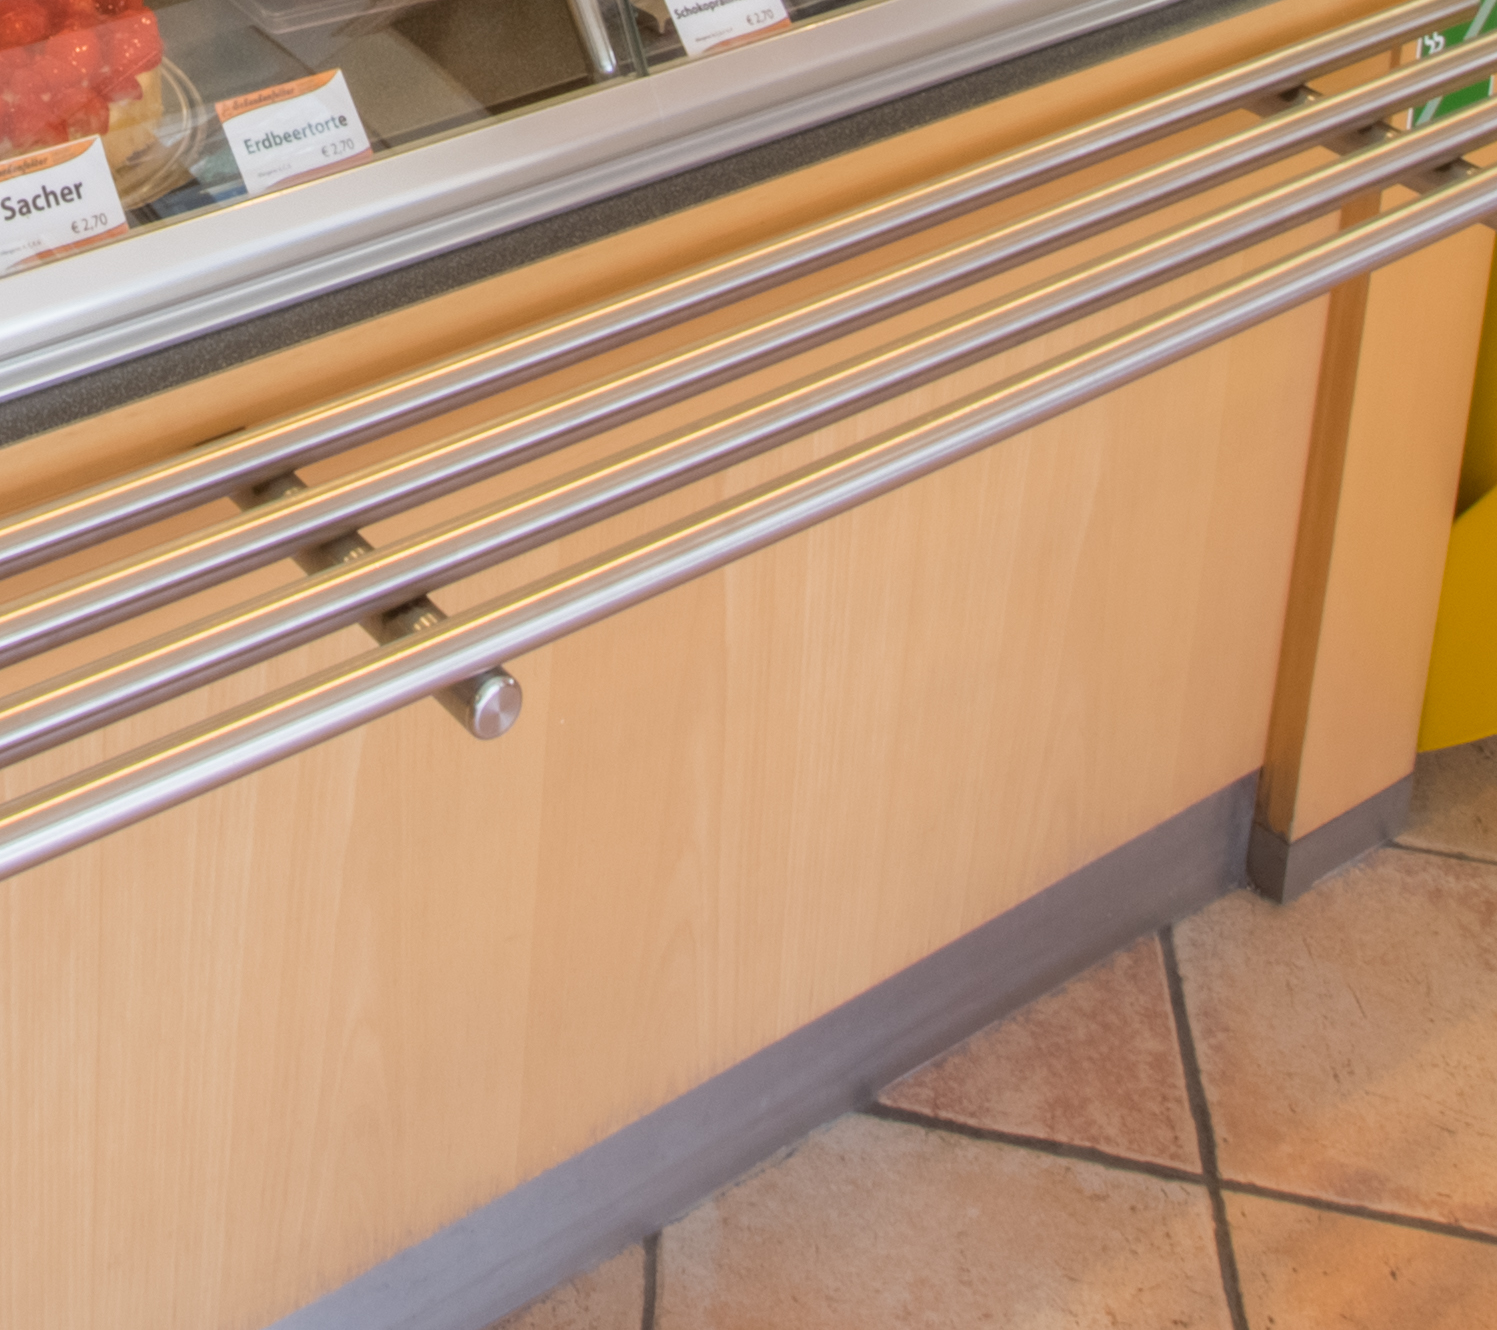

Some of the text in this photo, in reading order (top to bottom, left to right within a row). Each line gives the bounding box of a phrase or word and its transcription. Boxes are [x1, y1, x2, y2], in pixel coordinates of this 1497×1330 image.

[244, 114, 349, 155] Erdbeertorte
[0, 181, 83, 221] Sacher
[83, 213, 108, 232] 2,70
